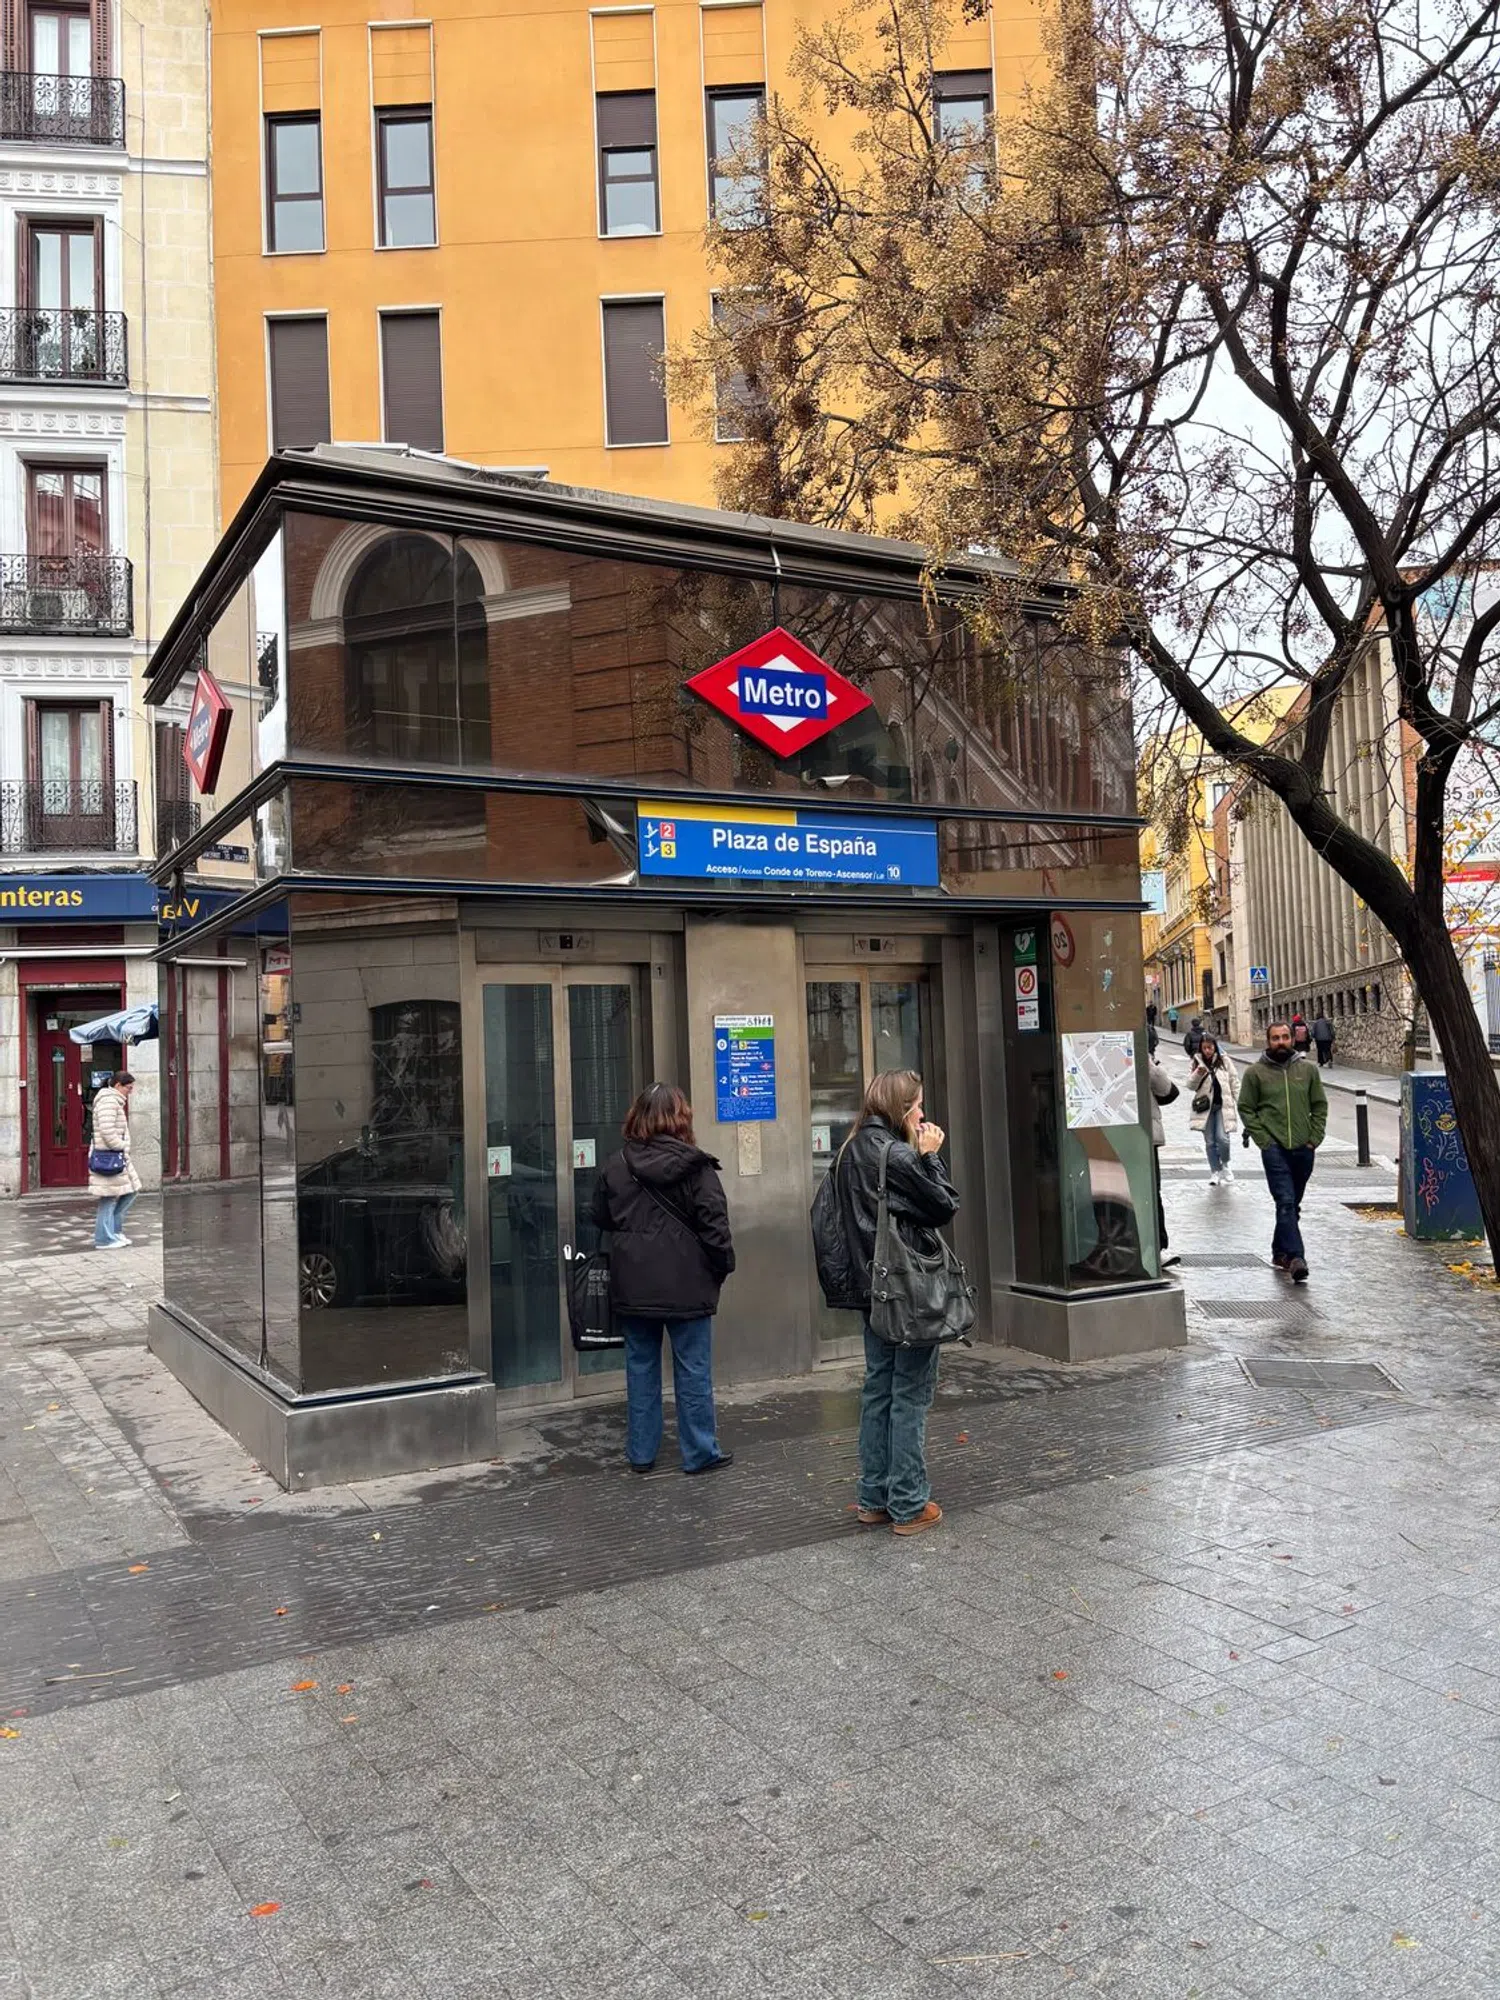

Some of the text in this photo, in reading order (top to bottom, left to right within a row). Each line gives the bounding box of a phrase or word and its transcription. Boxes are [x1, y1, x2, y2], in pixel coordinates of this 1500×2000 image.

[744, 677, 821, 709] Metro
[663, 824, 672, 837] 2
[664, 843, 673, 856] 3
[713, 828, 877, 859] Plaza de España
[764, 866, 791, 876] Conde
[793, 867, 803, 877] de
[888, 866, 899, 878] 10
[0, 885, 83, 907] nteras
